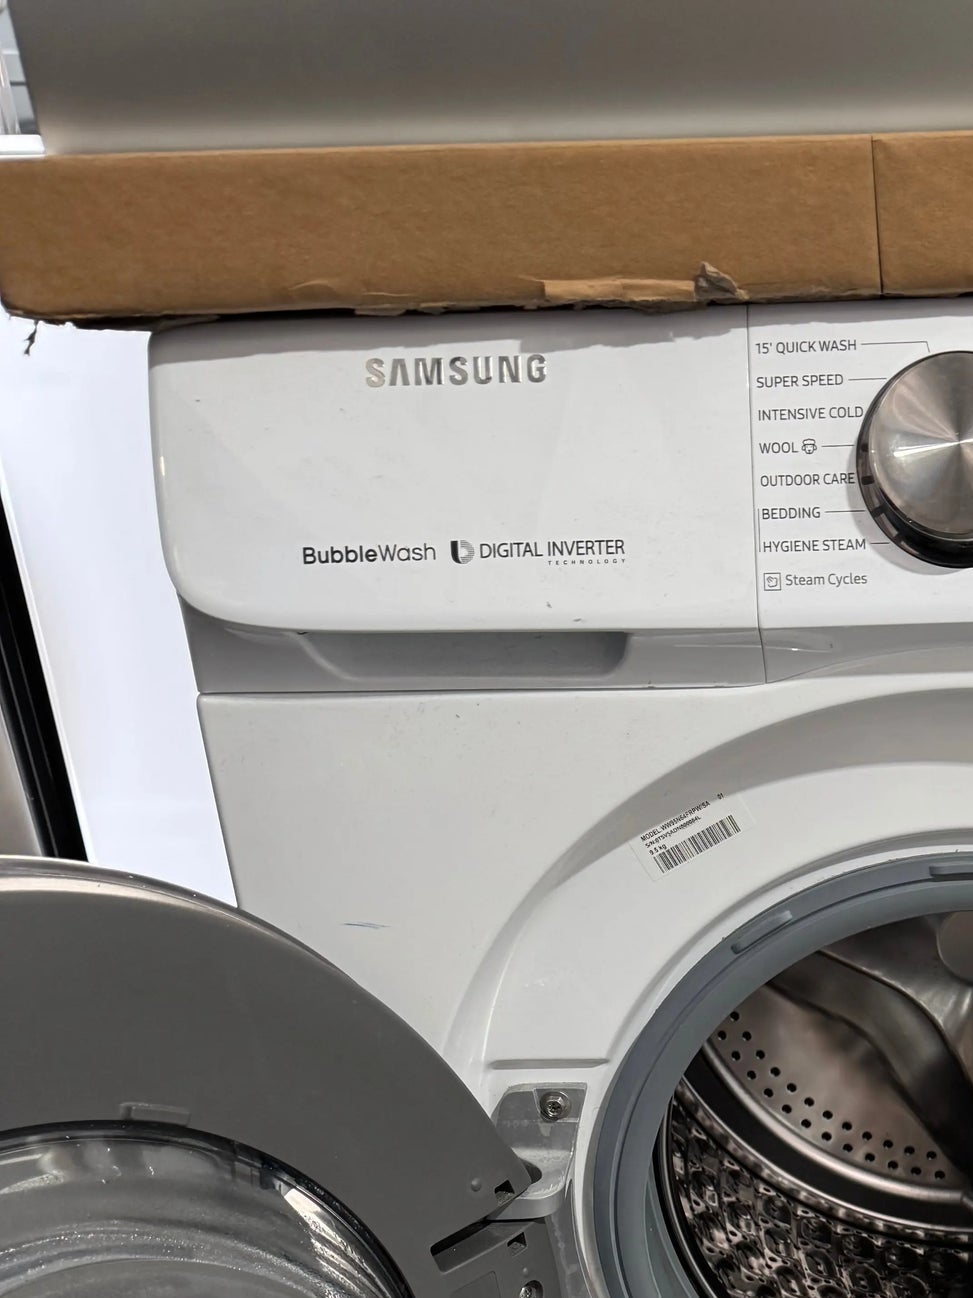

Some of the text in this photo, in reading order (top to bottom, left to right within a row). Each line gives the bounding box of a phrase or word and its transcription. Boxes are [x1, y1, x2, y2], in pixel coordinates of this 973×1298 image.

[776, 341, 816, 354] QUICK
[818, 340, 857, 352] WASH
[365, 354, 547, 387] SAMSUNG
[757, 374, 843, 388] SUPER SPEED
[758, 406, 863, 421] INTENSIVE COLD
[759, 442, 798, 454] WOOL
[760, 473, 855, 487] OUTDOOR CARE
[762, 507, 820, 520] BEDDING
[302, 539, 625, 565] BubbleWash DIGITAL INVERTER
[763, 539, 866, 553] HYGIENE STEAM
[548, 558, 627, 566] TECHNOLOGY
[785, 573, 868, 589] Steam Cycles
